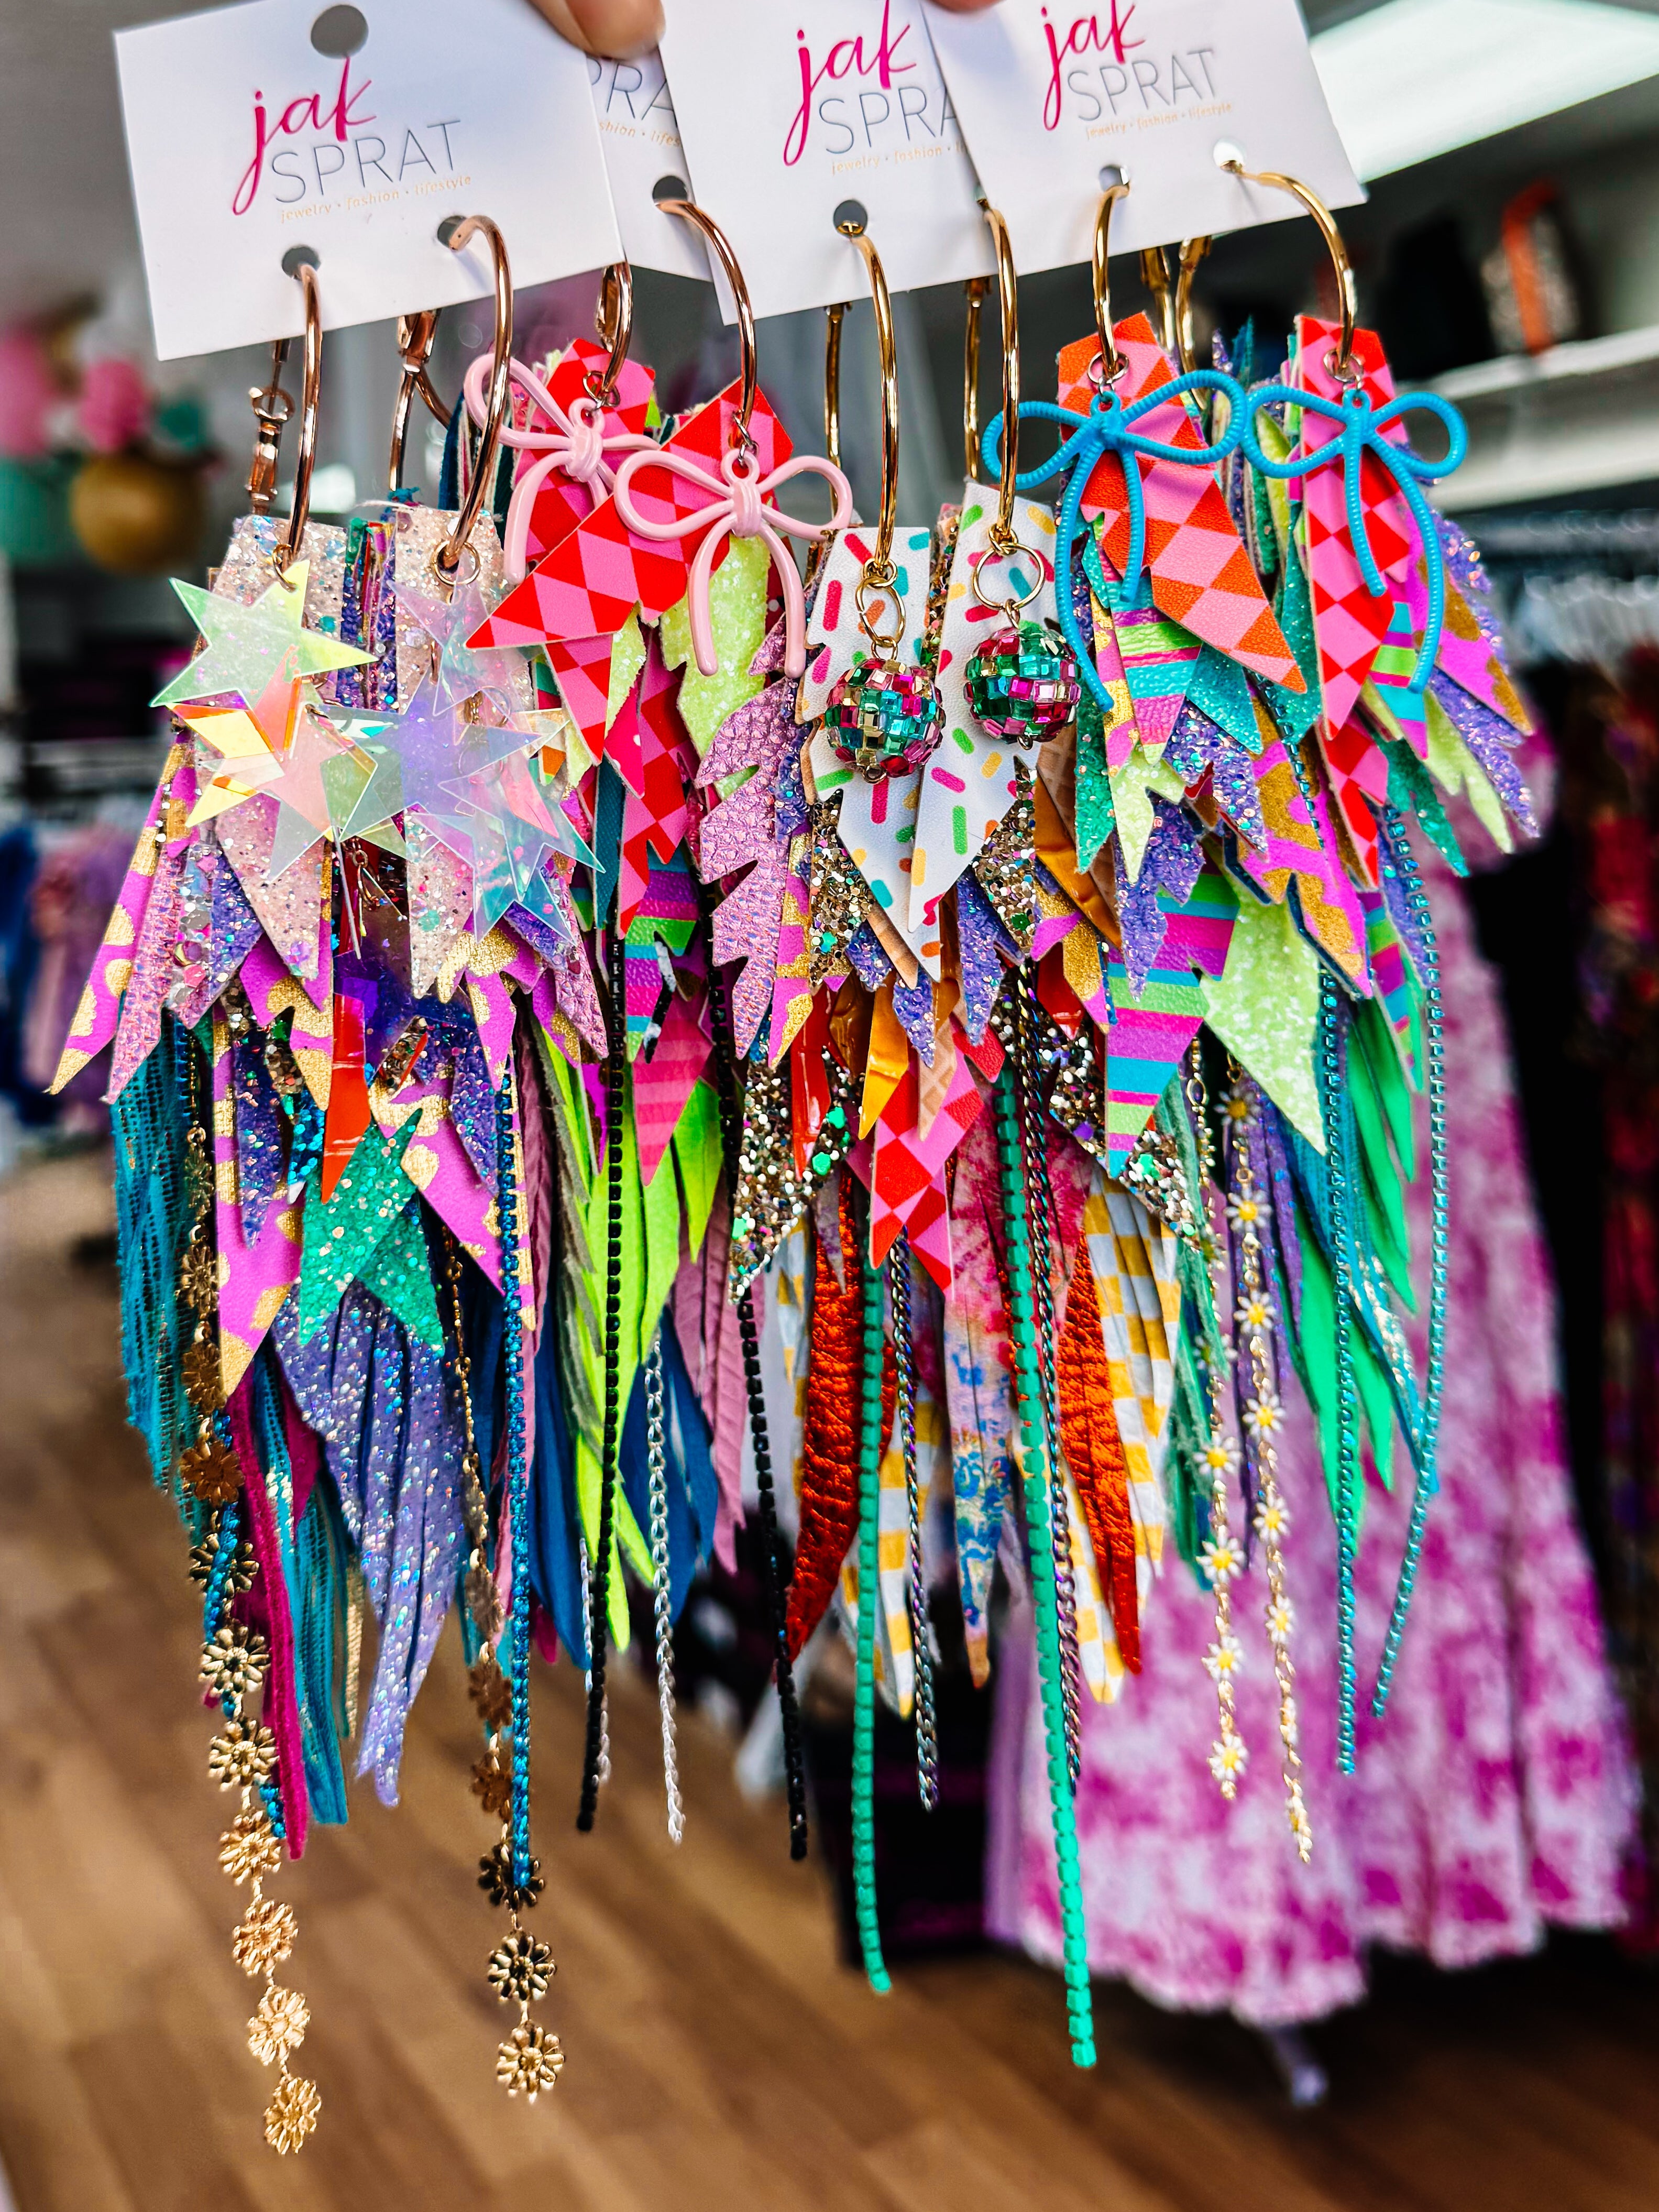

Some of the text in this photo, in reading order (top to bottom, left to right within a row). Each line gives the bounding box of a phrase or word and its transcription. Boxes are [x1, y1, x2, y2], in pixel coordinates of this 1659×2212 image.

[784, 0, 917, 166] jak
[1040, 0, 1146, 131] jak
[1067, 48, 1214, 122] SPRAT
[233, 57, 377, 215] jak
[599, 121, 636, 138] shion
[819, 85, 957, 154] SPRA
[1137, 113, 1179, 129] fashion
[1189, 102, 1232, 119] lifestyle
[272, 119, 461, 204] SPRAT
[831, 156, 881, 177] jewelry
[894, 145, 942, 165] fashion
[280, 174, 471, 224] jewelry fashion lifestyle
